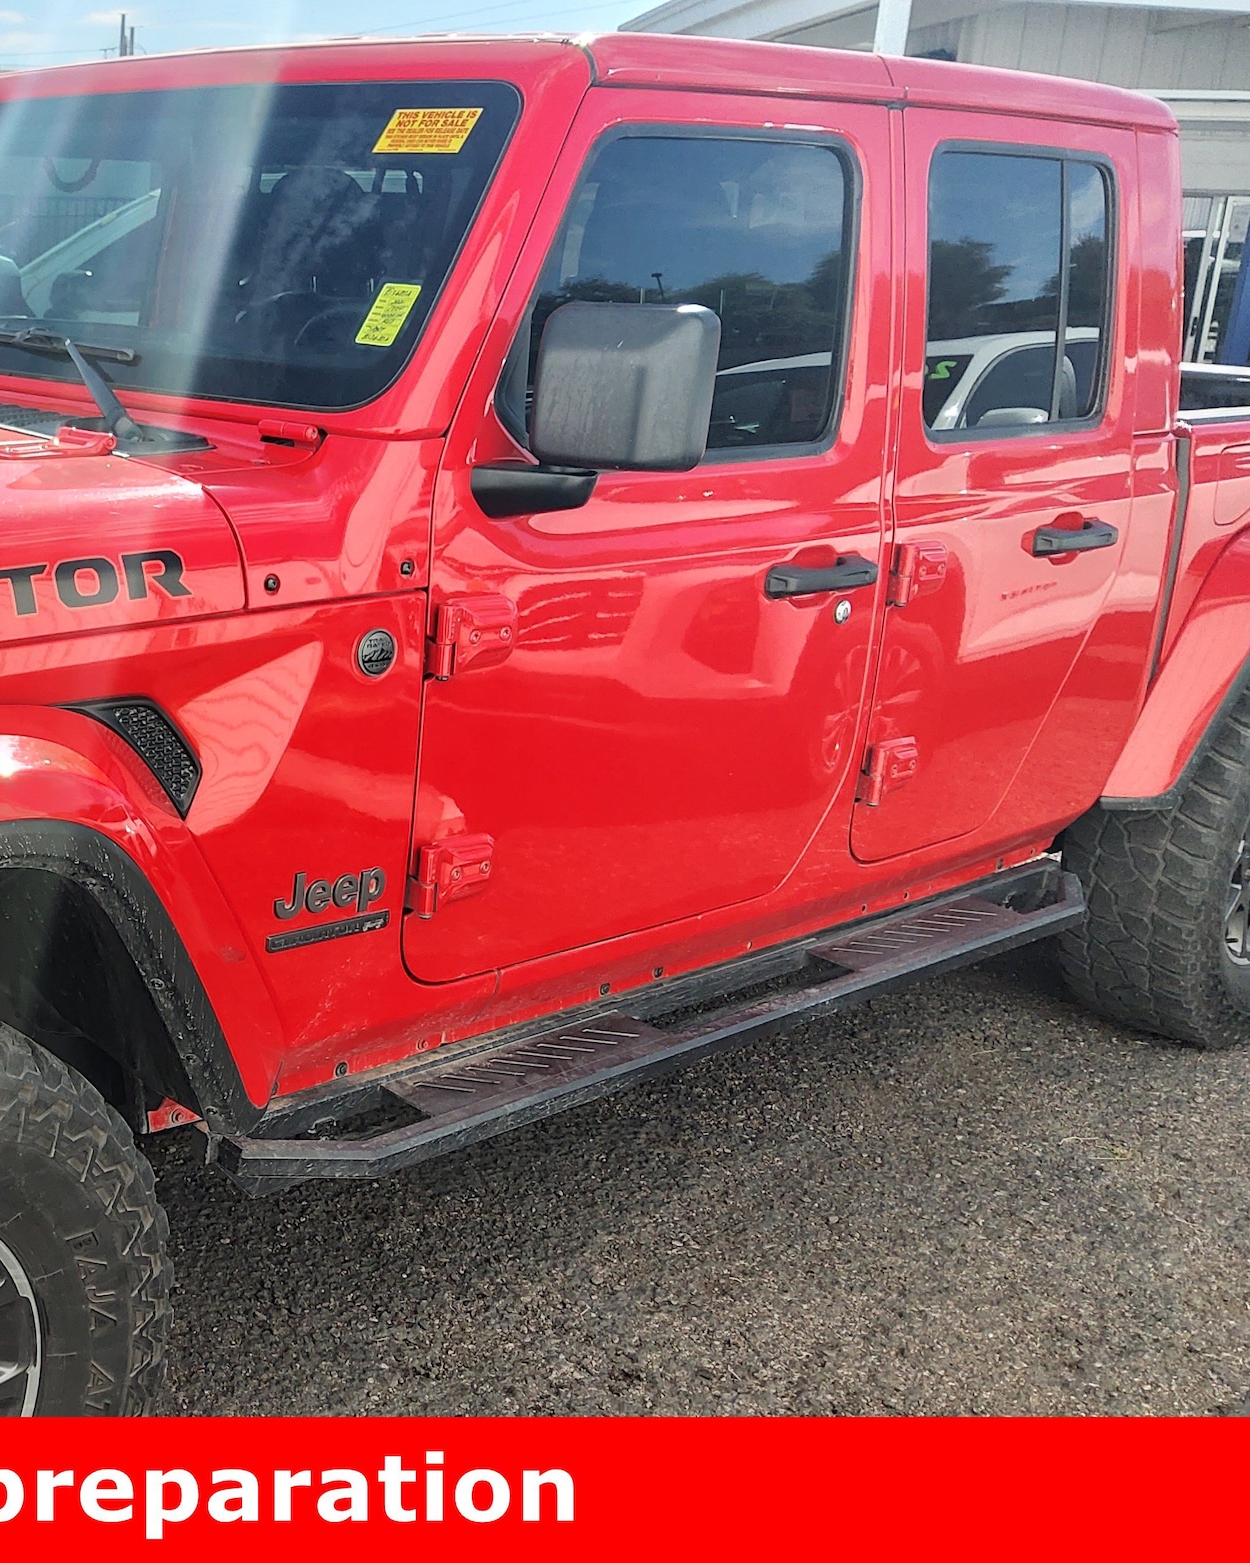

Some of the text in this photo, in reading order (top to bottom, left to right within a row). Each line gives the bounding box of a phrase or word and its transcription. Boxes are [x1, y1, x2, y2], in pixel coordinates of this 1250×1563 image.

[397, 110, 478, 119] THIS VEHICLE IS
[418, 119, 440, 127] FOR
[441, 119, 469, 127] SALE
[273, 866, 386, 919] Jeep
[64, 1230, 119, 1340] BAJA
